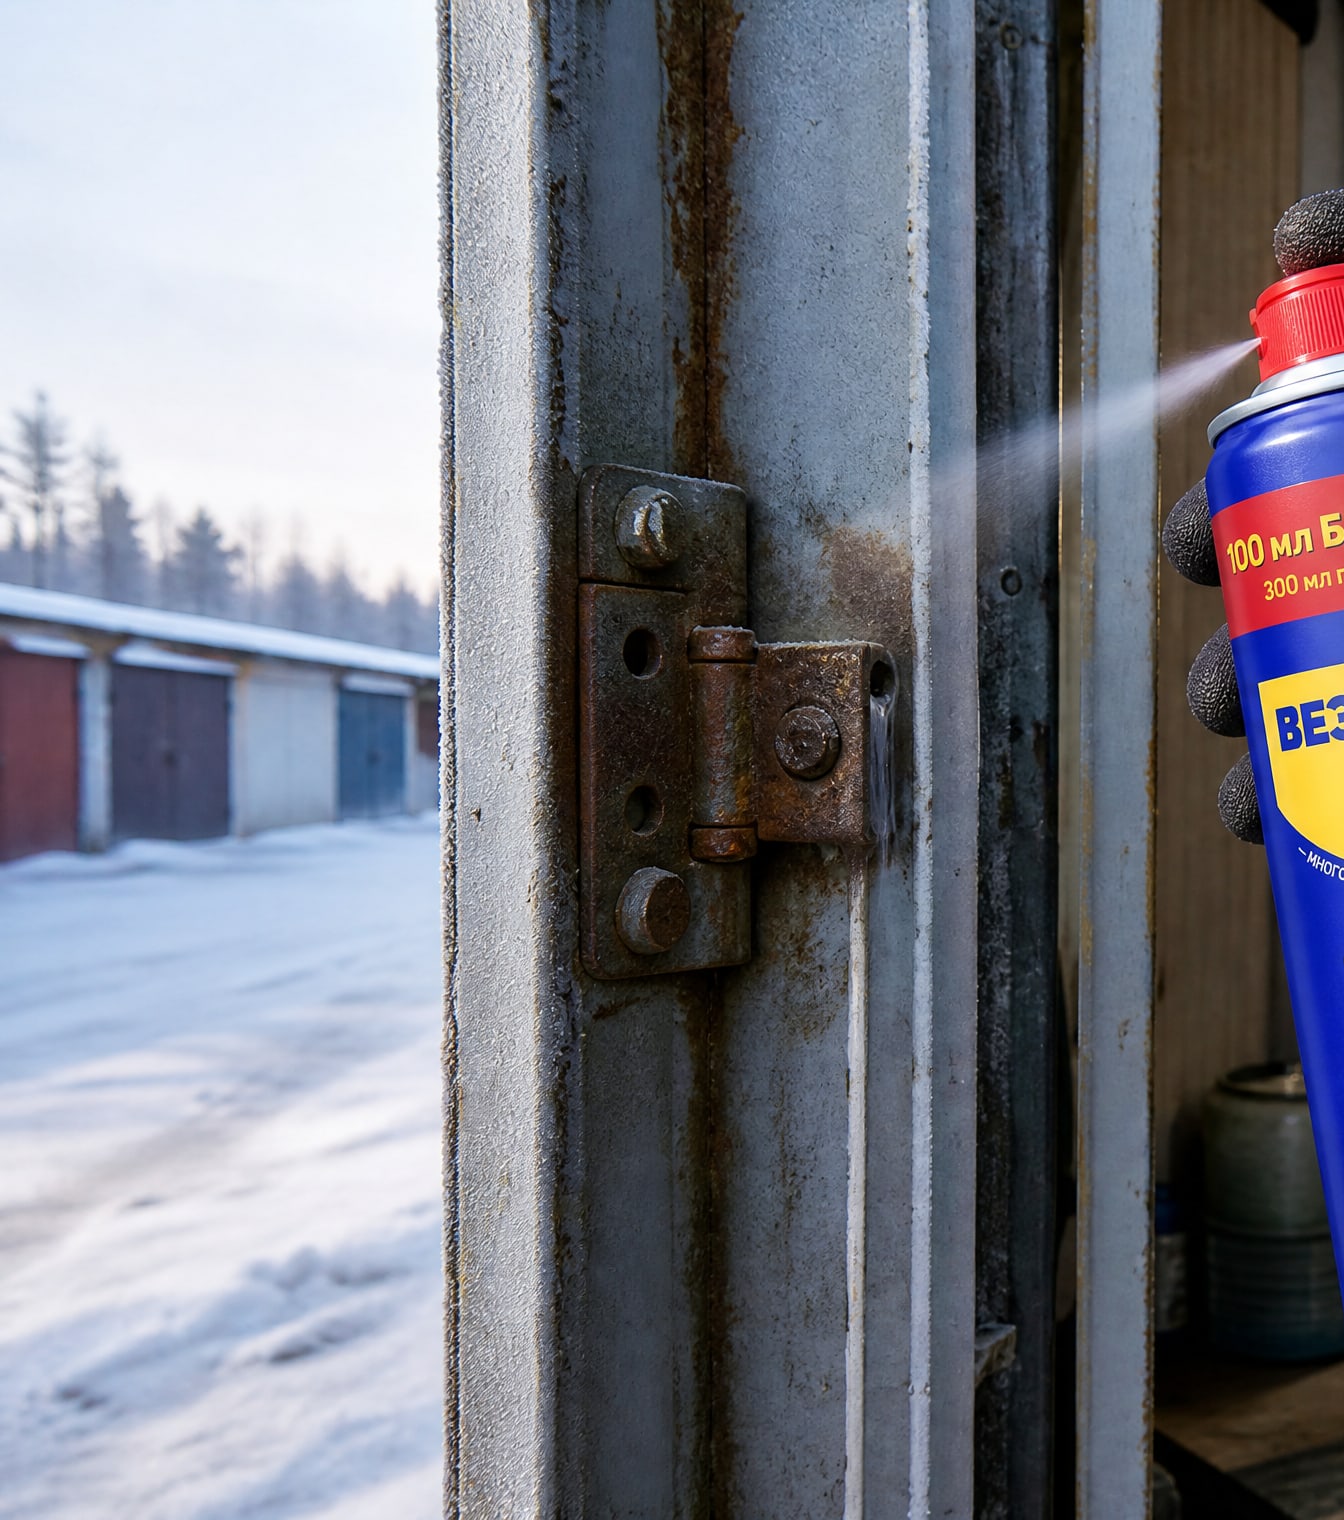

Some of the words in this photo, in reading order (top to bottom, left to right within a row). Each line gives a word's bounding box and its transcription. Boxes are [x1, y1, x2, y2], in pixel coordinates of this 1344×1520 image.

[1226, 533, 1265, 575] 100
[1269, 527, 1314, 562] мл
[1263, 574, 1299, 601] 300
[1303, 571, 1332, 592] мл
